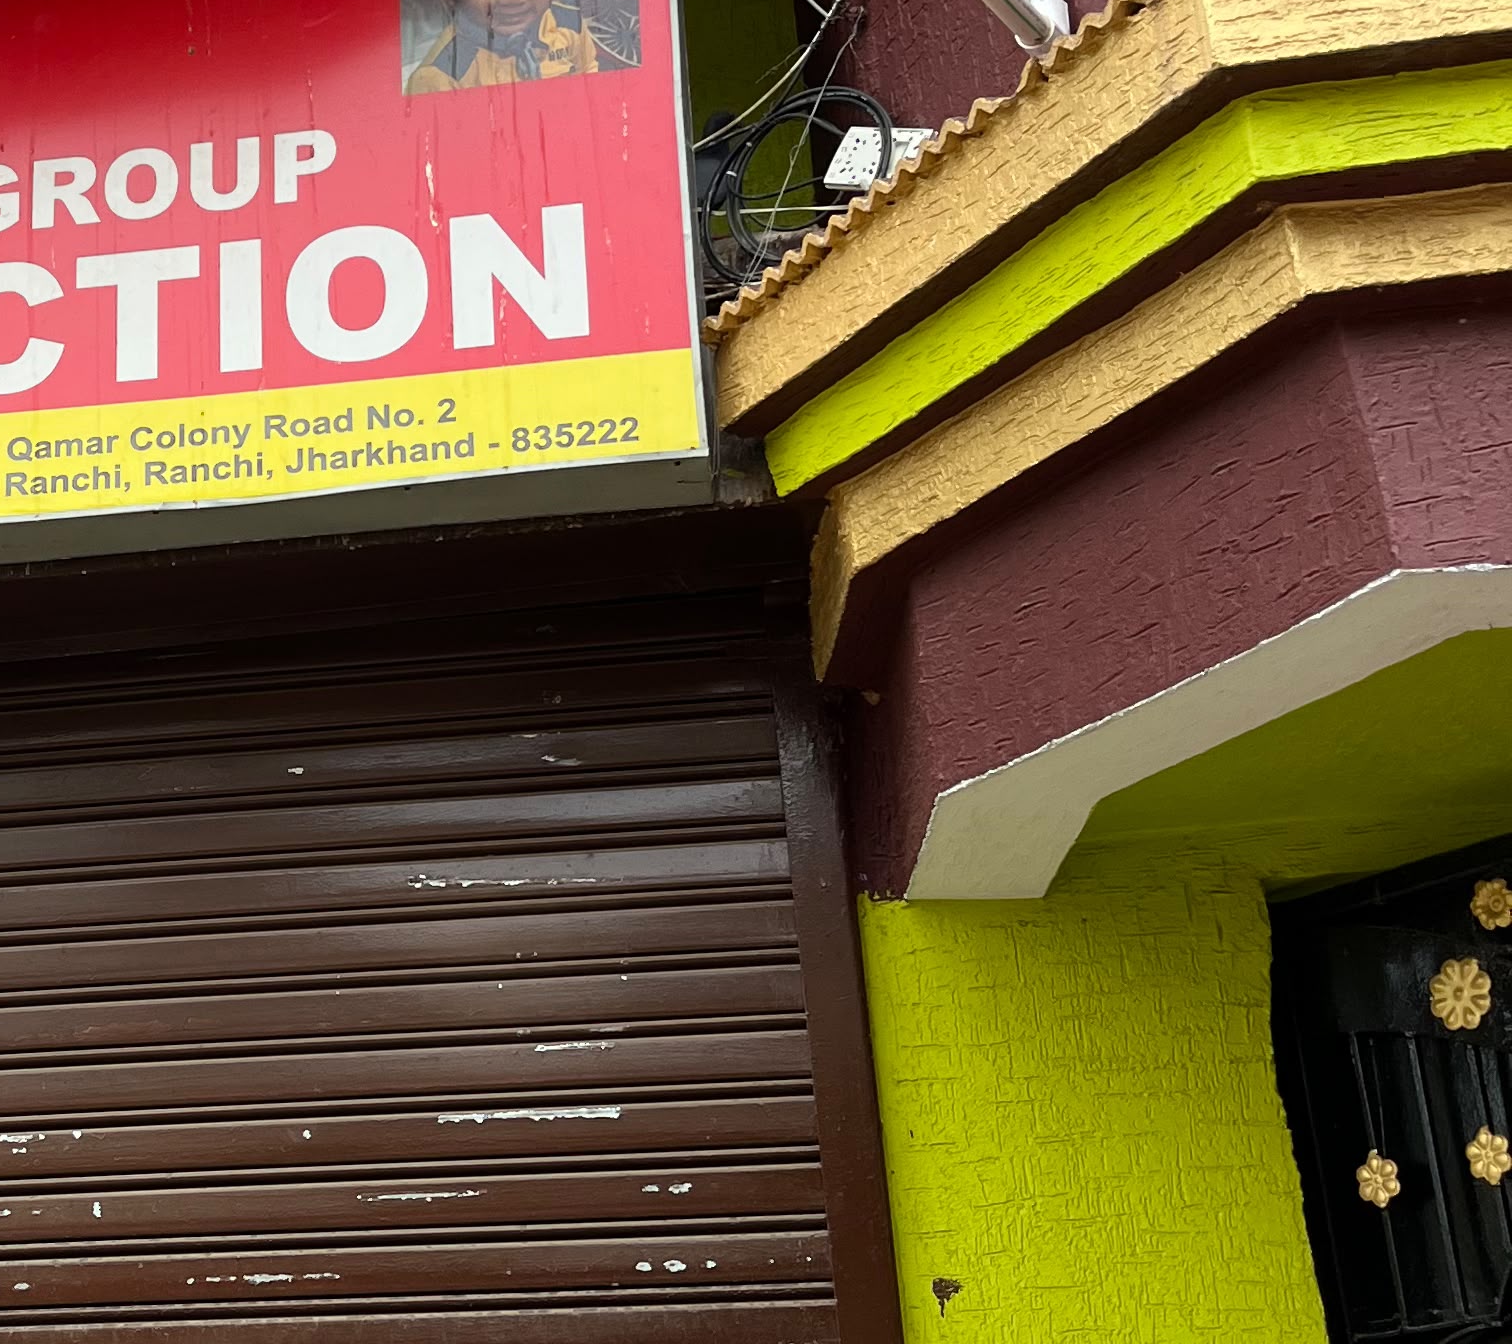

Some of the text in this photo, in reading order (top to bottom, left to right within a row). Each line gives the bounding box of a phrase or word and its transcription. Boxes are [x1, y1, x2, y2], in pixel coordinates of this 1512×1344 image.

[4, 465, 131, 497] Ranchi,
[144, 452, 273, 487] Ranchi,
[284, 432, 475, 474] Jharkhand
[511, 417, 640, 453] 835222
[6, 434, 120, 462] Qamar
[129, 423, 251, 452] Colony
[264, 407, 354, 440] Road
[368, 404, 424, 431] No.
[437, 398, 457, 424] 2
